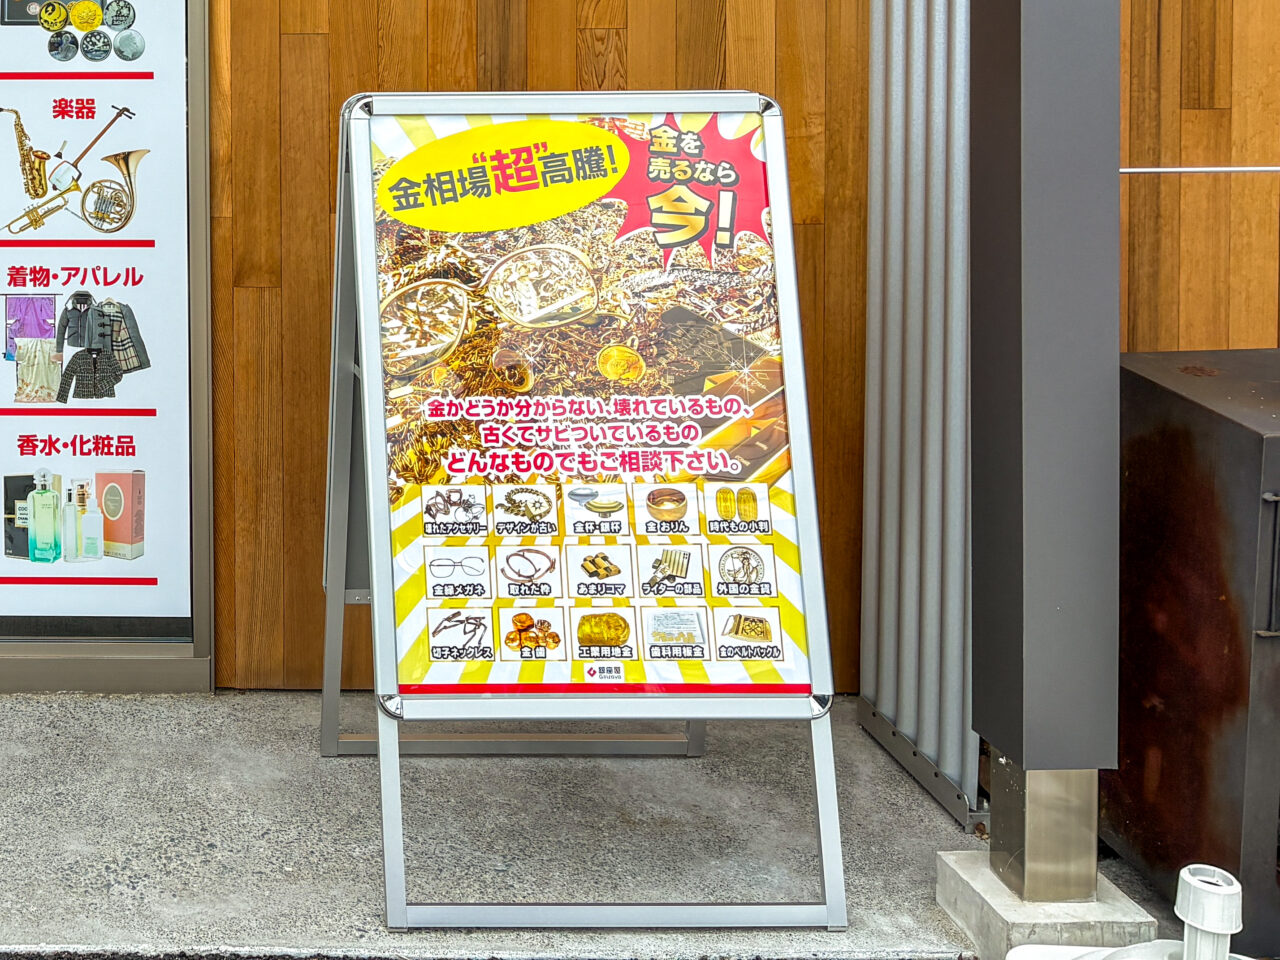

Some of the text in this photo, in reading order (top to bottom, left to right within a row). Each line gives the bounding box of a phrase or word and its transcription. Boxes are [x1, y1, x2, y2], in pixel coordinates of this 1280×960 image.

[52, 98, 97, 120] 楽器
[648, 124, 705, 157] 金を
[647, 157, 739, 187] 売るなら
[7, 265, 144, 288] 着物・アパレル
[427, 397, 751, 418] 金かどうか分からない、壊れているもの、
[482, 424, 699, 444] 古くてサビついているもの
[17, 434, 136, 457] 香水・化粧品
[447, 451, 739, 473] どんなものでもご相談下さい。
[496, 521, 557, 535] デザインが古い
[577, 583, 626, 596] あまりコマ
